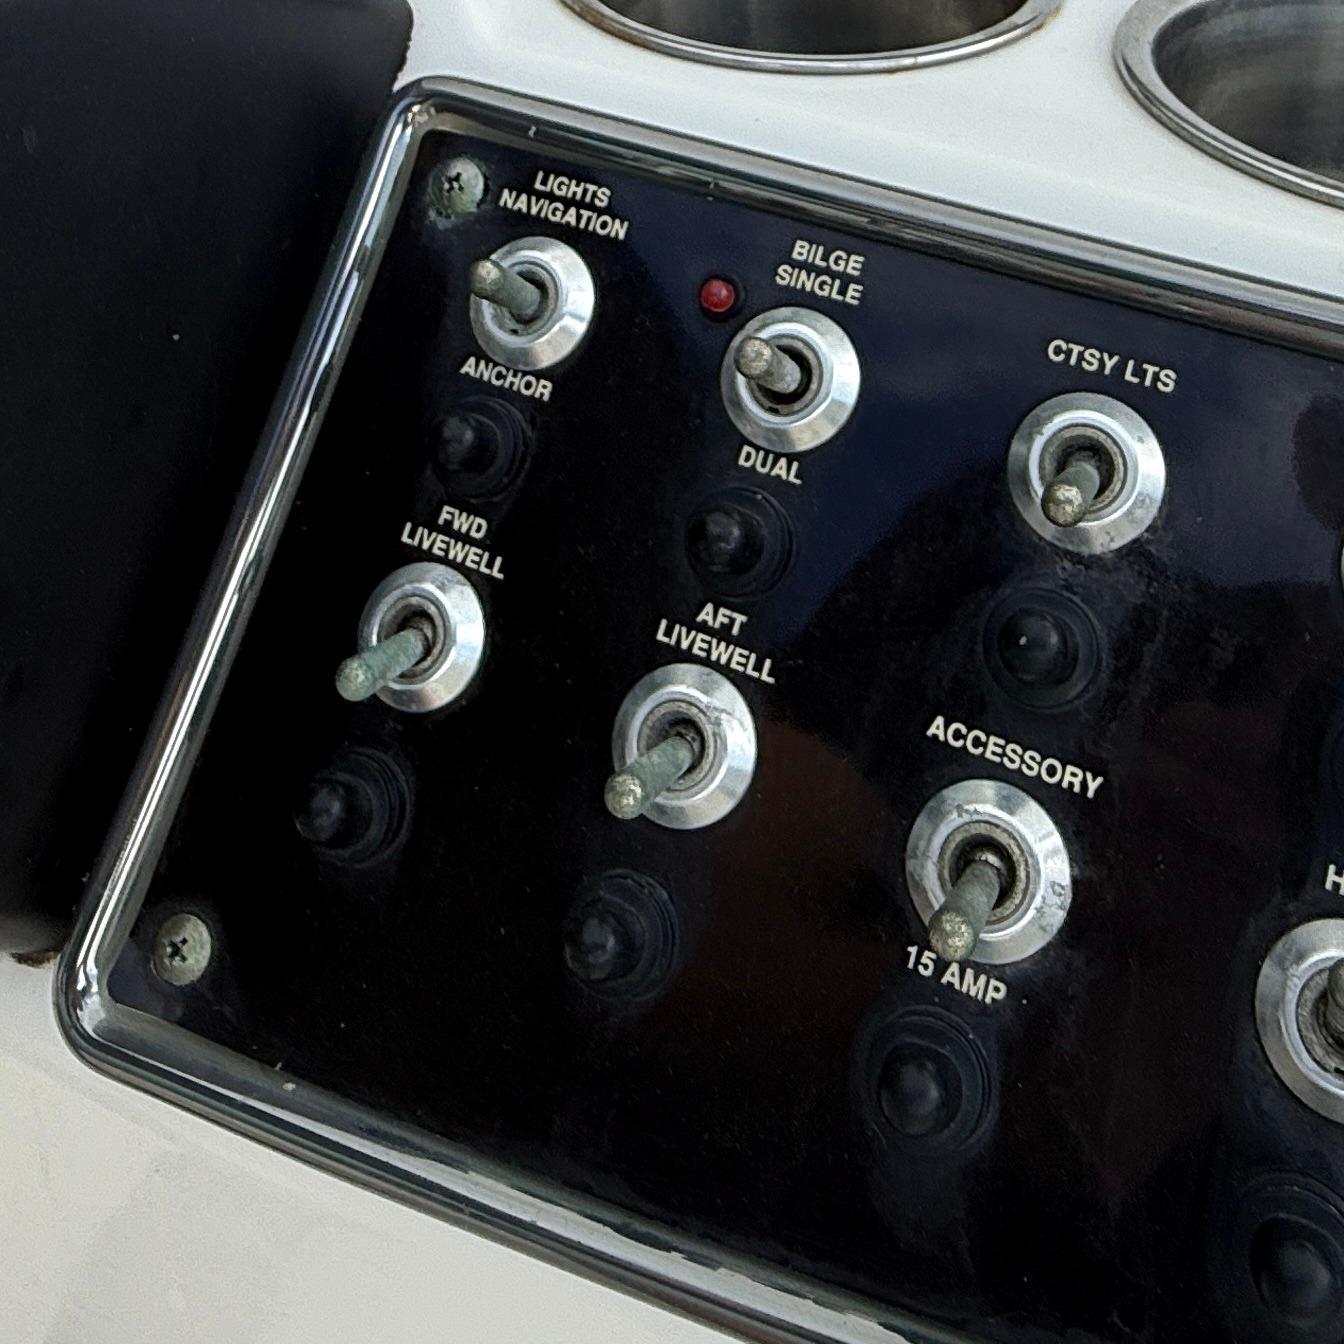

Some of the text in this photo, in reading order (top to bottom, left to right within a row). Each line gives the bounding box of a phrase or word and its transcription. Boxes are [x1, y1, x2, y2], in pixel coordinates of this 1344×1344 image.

[534, 170, 612, 207] LIGHTS
[499, 188, 629, 241] NAVIGATION
[791, 240, 864, 276] BILGE
[775, 265, 863, 305] SINGLE
[459, 355, 553, 402] ANCHOR
[1046, 339, 1178, 393] CTSY LTS
[737, 445, 802, 485] DUAL
[437, 504, 489, 540] FWD
[400, 522, 505, 580] LIVEWELL
[695, 602, 749, 636] AFT
[655, 619, 776, 684] LIVEWELL
[925, 715, 1104, 799] ACCESSORY
[906, 946, 1007, 1005] 15 AMP
